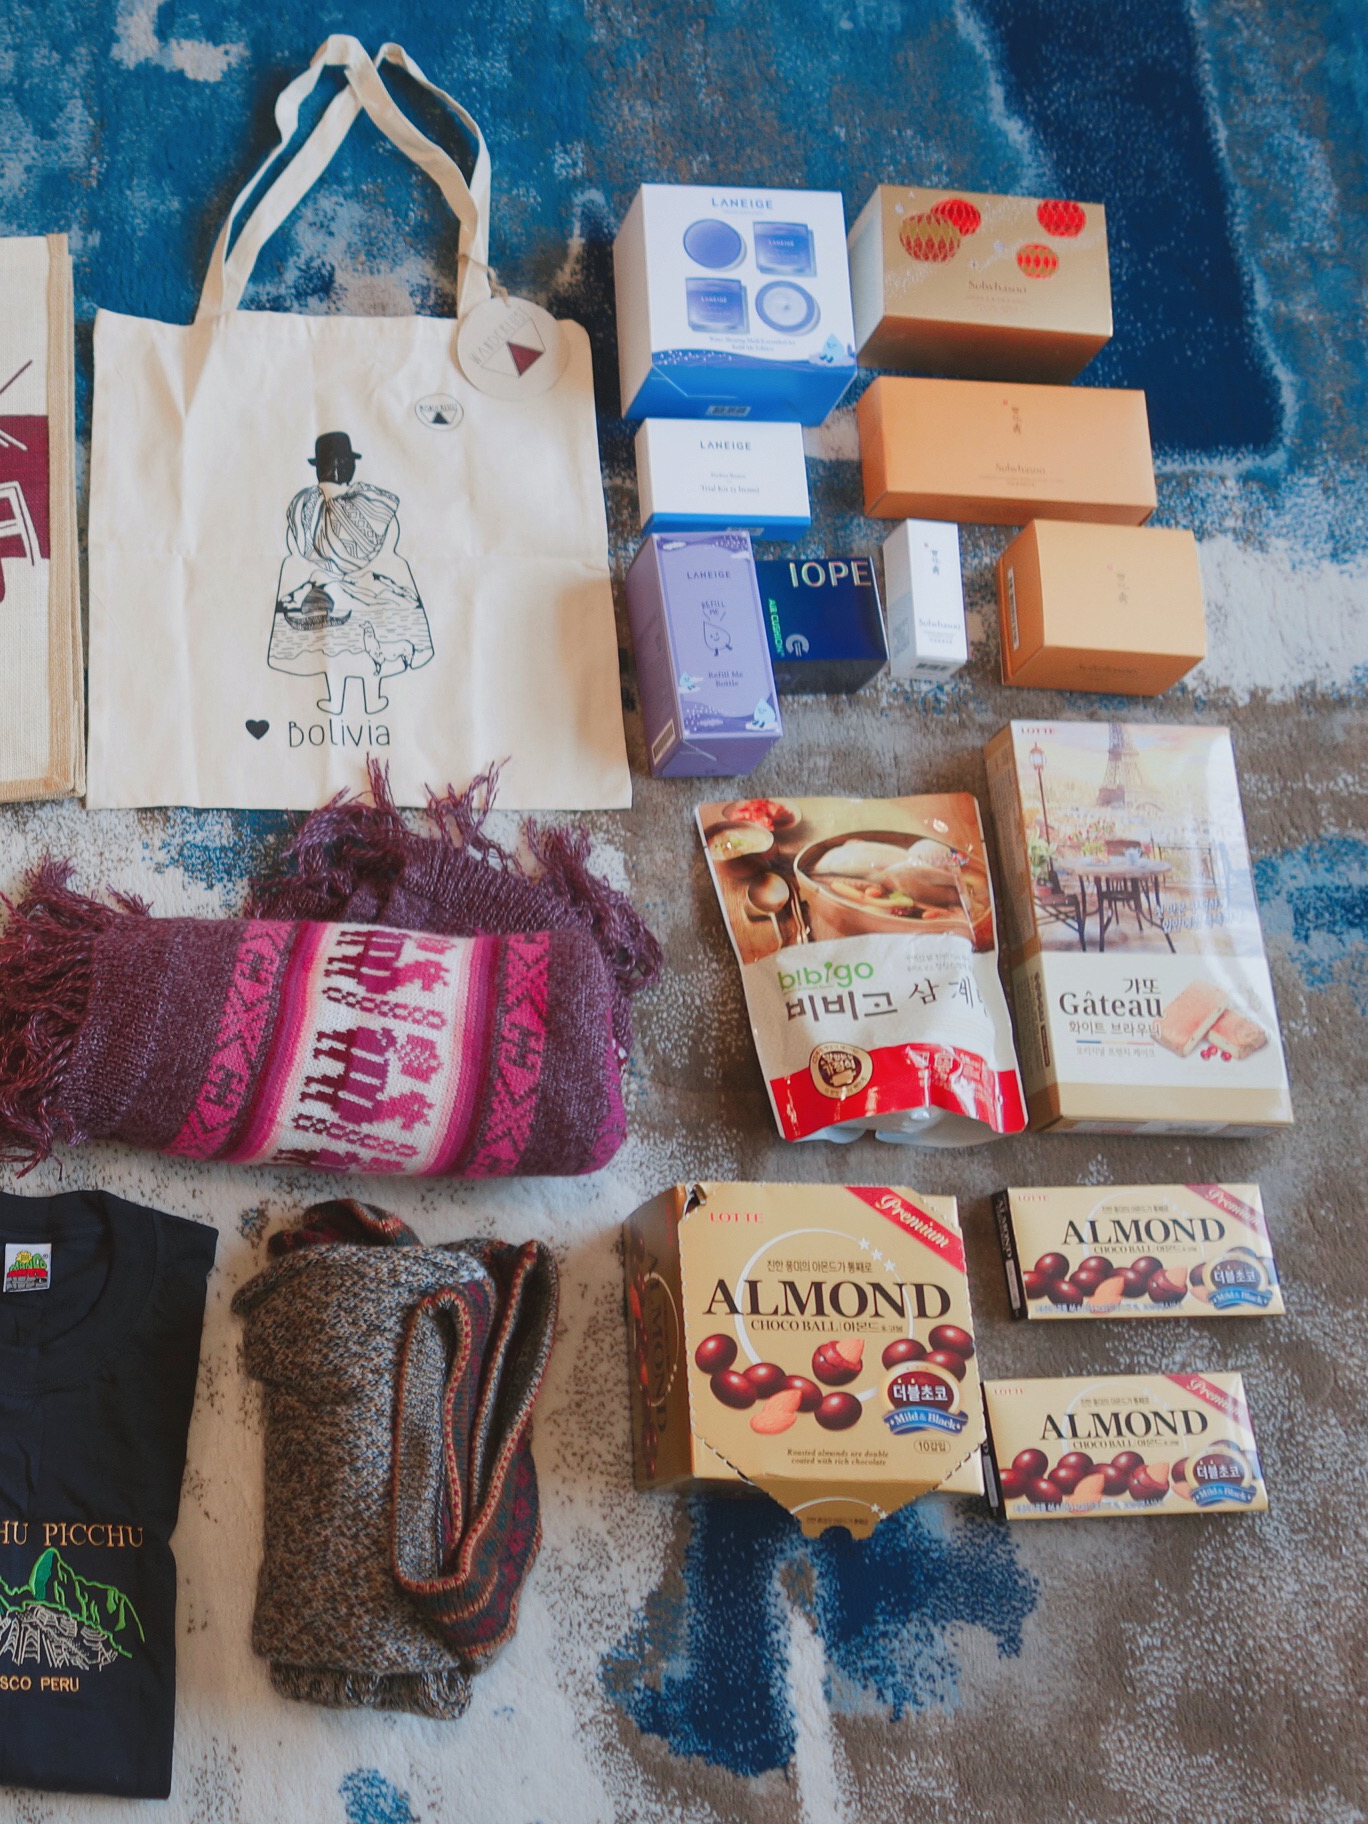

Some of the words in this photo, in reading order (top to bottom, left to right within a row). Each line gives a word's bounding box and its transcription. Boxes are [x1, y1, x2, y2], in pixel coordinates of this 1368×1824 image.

[711, 198, 773, 210] LANEIGE
[700, 440, 751, 450] LANEIGE
[687, 571, 731, 579] LANEIGE
[789, 561, 873, 588] IOPE
[288, 719, 391, 748] Bolivia
[1021, 727, 1057, 735] LOTTE
[778, 961, 873, 992] bibigo
[1123, 978, 1161, 994] 가또
[909, 976, 987, 1016] 삼계
[1059, 990, 1163, 1018] Gâteau
[785, 991, 897, 1021] 비비고
[1069, 1021, 1106, 1035] 화이트
[1111, 1022, 1160, 1037] 브라우니
[709, 1211, 763, 1224] LOTTE
[876, 1193, 949, 1249] Premium
[1061, 1218, 1225, 1246] ALMOND
[1094, 1246, 1126, 1254] CHOCO
[703, 1278, 951, 1320] ALMOND
[751, 1319, 799, 1332] CHOCO
[802, 1321, 838, 1333] BALL
[843, 1321, 882, 1334] 아몬드
[893, 1383, 948, 1401] 더블초코
[894, 1411, 918, 1425] Mild
[928, 1413, 956, 1430] Black
[1040, 1409, 1208, 1441] ALMOND
[818, 1449, 848, 1457] almonds
[1196, 1464, 1241, 1480] 더블초코
[42, 1522, 144, 1548] PICCHU
[40, 1676, 80, 1692] PERU
